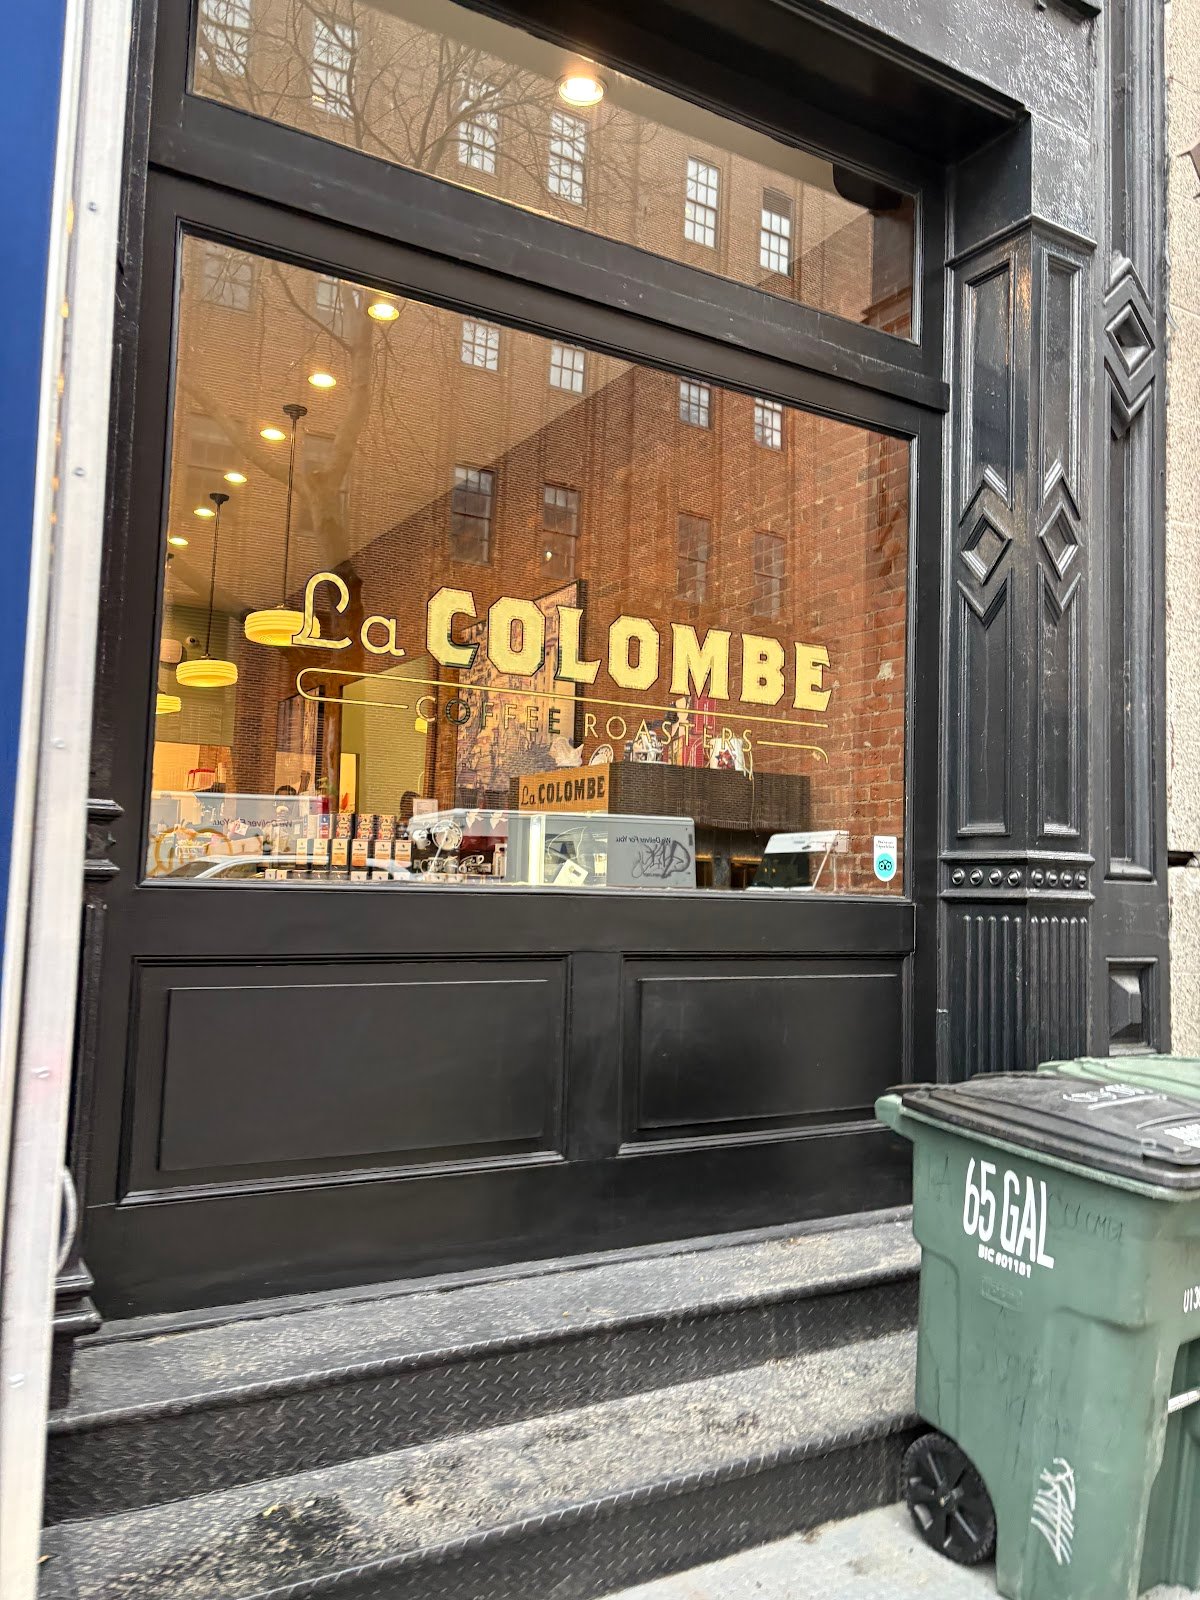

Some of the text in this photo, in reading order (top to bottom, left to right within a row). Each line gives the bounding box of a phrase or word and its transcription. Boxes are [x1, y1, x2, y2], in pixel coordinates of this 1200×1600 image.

[291, 572, 833, 712] La COLOMBE
[415, 695, 752, 752] COFFEE ROASTERS
[520, 775, 606, 806] La COLOMBE
[962, 1157, 997, 1242] 65
[1000, 1169, 1055, 1269] GAL
